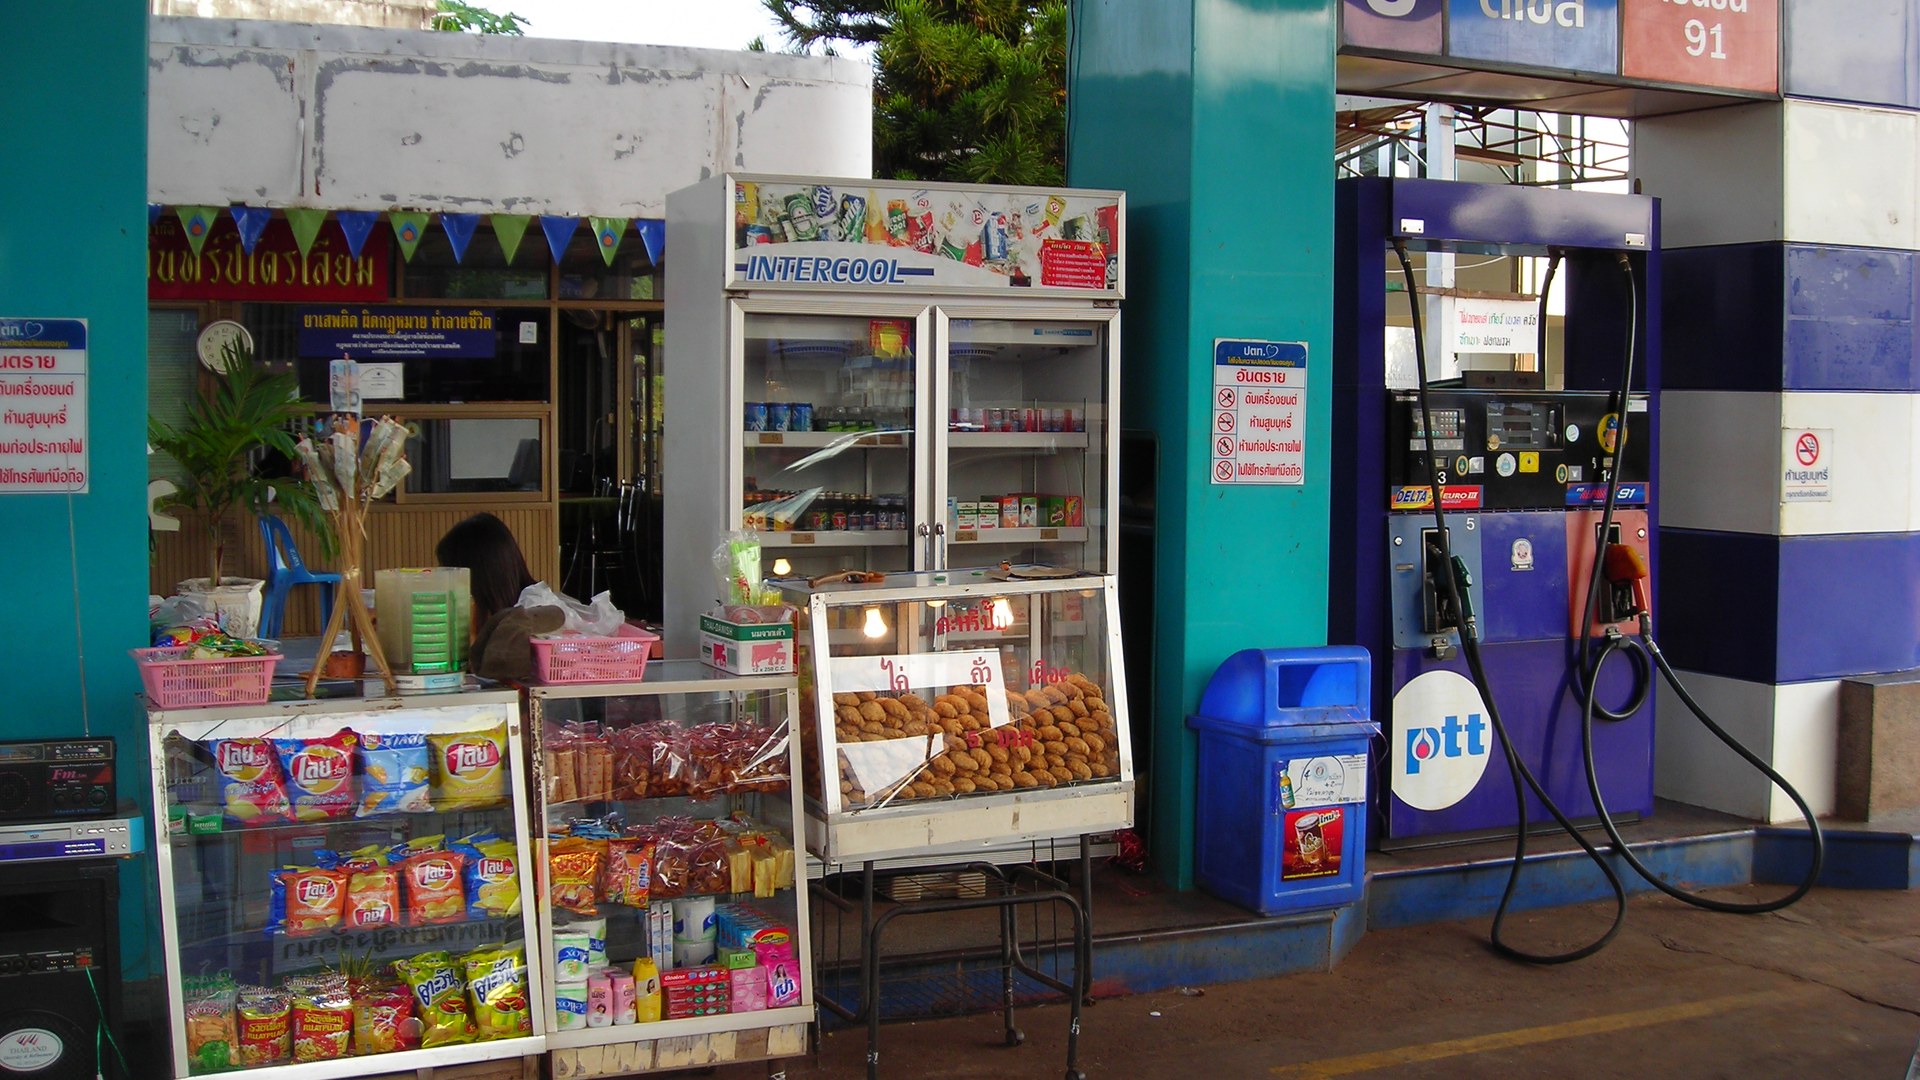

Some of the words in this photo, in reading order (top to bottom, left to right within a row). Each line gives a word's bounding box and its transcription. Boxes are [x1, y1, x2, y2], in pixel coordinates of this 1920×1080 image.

[1684, 19, 1726, 59] 91
[147, 232, 374, 287] นทร์ปิโตรเลียม
[747, 255, 905, 285] INTERCOOL
[0, 325, 24, 336] ตท.
[304, 309, 358, 328] ยาเสพติด
[362, 309, 427, 334] ผิดกฎหมาย
[432, 309, 492, 329] ทำลายชีวิต
[1243, 345, 1266, 357] ปตท.
[0, 355, 56, 368] นตราย
[1236, 368, 1286, 384] อันตราย
[1245, 389, 1298, 406] ดับเครื่องยนต์
[4, 404, 67, 429] ห้ามสูบบุหรี่
[1250, 412, 1292, 432] ห้ามสูบบุหรี่
[1239, 439, 1302, 453] ห้ามก่อประกายไฟ
[1437, 471, 1447, 484] 3
[1785, 466, 1829, 484] ห้ามสูบบุหรี่
[1395, 489, 1428, 503] DELTA
[1442, 492, 1467, 500] EURO
[1617, 488, 1636, 499] 91
[1466, 517, 1475, 530] 5
[880, 656, 910, 692] ไก่
[970, 656, 992, 684] ถั่ว
[965, 730, 980, 749] 5
[999, 730, 1034, 749] บาท
[1406, 713, 1486, 775] ptt
[457, 740, 491, 773] เลย์
[416, 967, 461, 1007] ตะวัน
[775, 980, 797, 999] เปา
